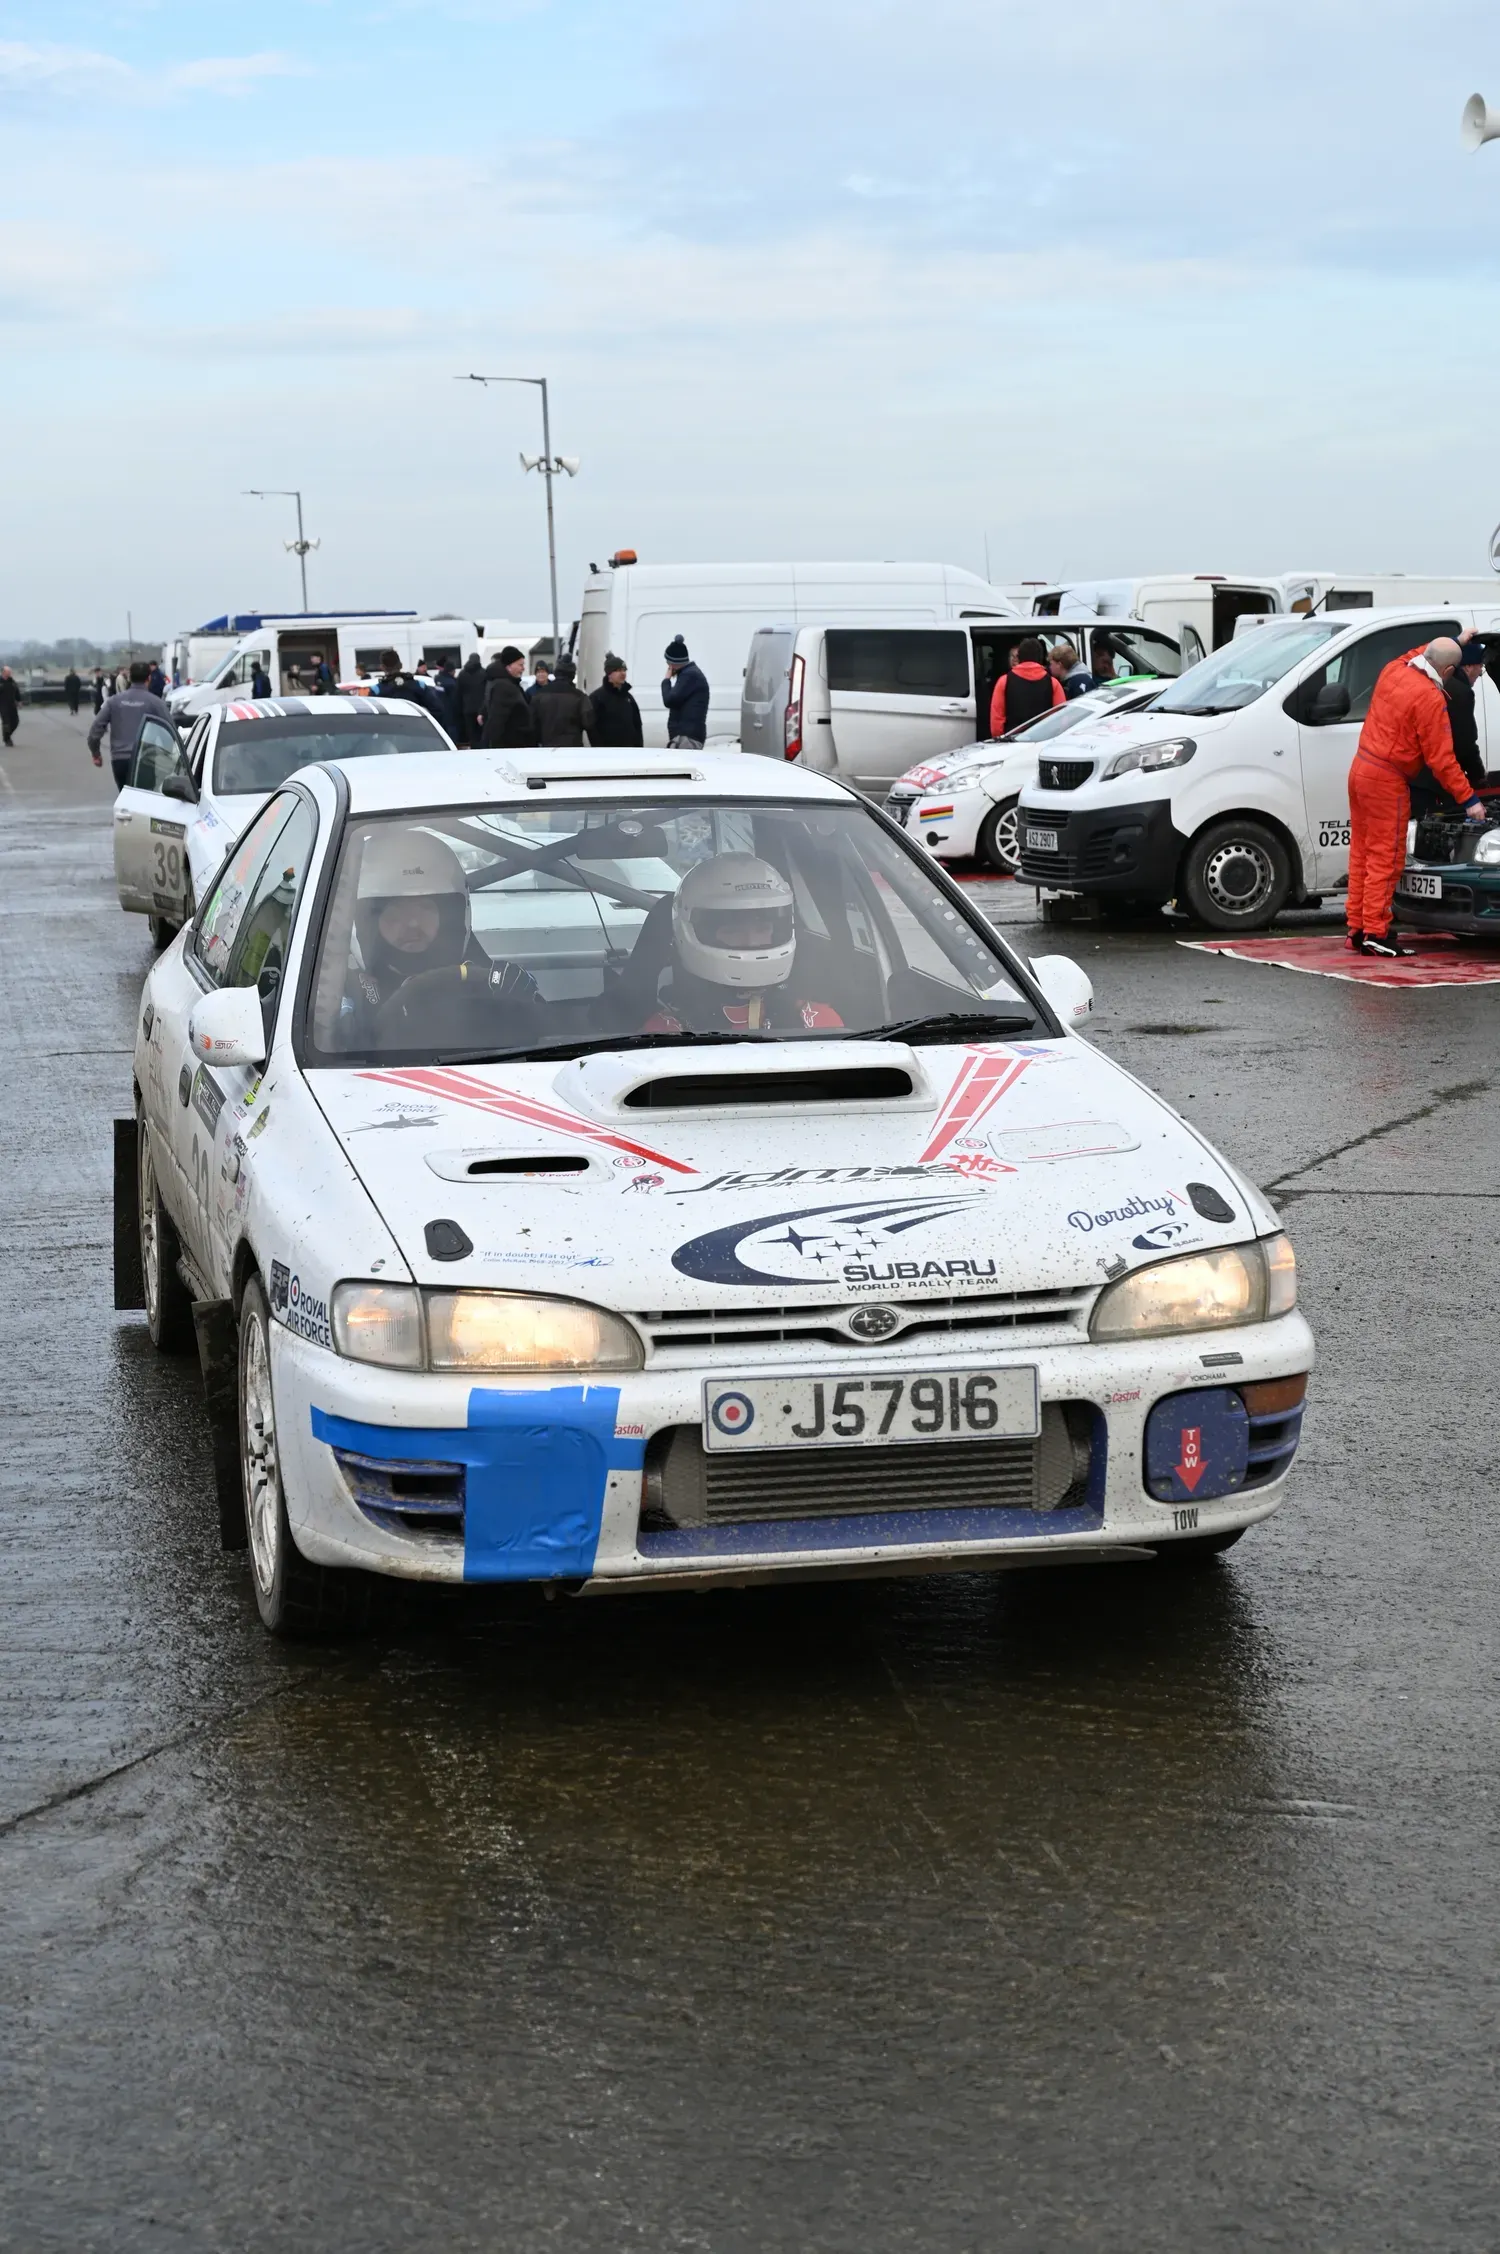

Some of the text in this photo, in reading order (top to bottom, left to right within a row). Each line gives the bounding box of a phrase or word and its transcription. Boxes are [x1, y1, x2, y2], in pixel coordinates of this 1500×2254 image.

[1320, 831, 1350, 847] 028
[153, 842, 180, 891] 39
[1411, 876, 1436, 895] 5275
[1067, 1196, 1175, 1232] Dorothy
[1173, 1237, 1204, 1248] SUBARU
[843, 1259, 996, 1282] SUBARU
[847, 1277, 999, 1292] WORLD RALLY TEAM
[300, 1292, 329, 1324] ROYAL
[286, 1308, 331, 1347] AIR FORCE
[1189, 1372, 1227, 1383] YOKOHAMA
[791, 1375, 998, 1438] J57916
[1112, 1390, 1141, 1403] Castrol
[1184, 1429, 1198, 1468] TOW
[1173, 1508, 1199, 1531] TOW
